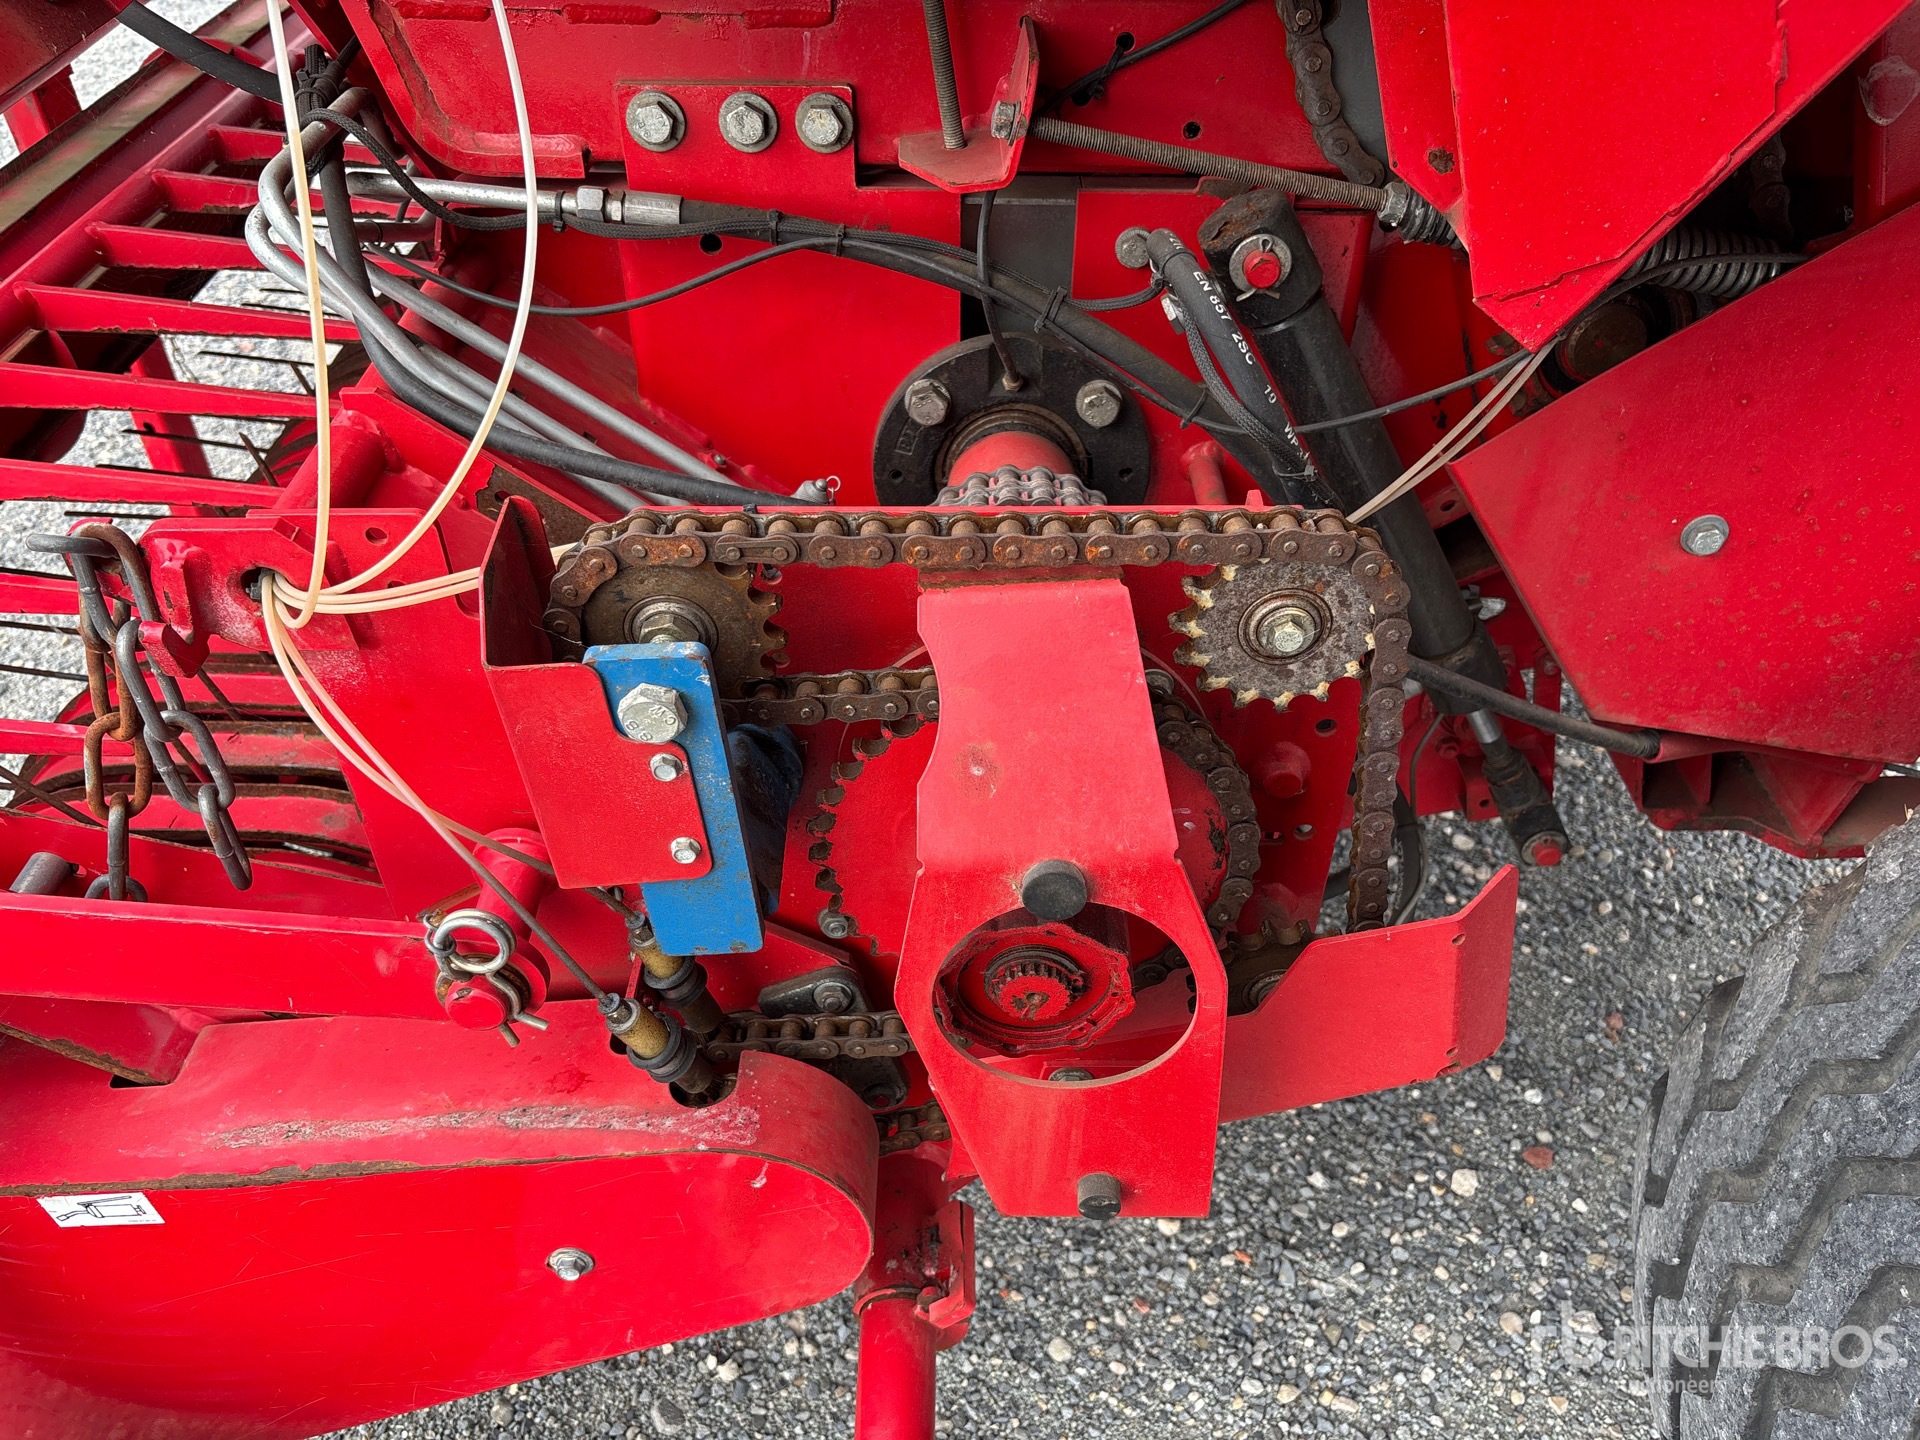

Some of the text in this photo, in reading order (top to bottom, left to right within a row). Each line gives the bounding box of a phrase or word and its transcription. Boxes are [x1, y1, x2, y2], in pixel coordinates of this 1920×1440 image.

[1193, 271, 1299, 446] EN 857 2SC 10 WP
